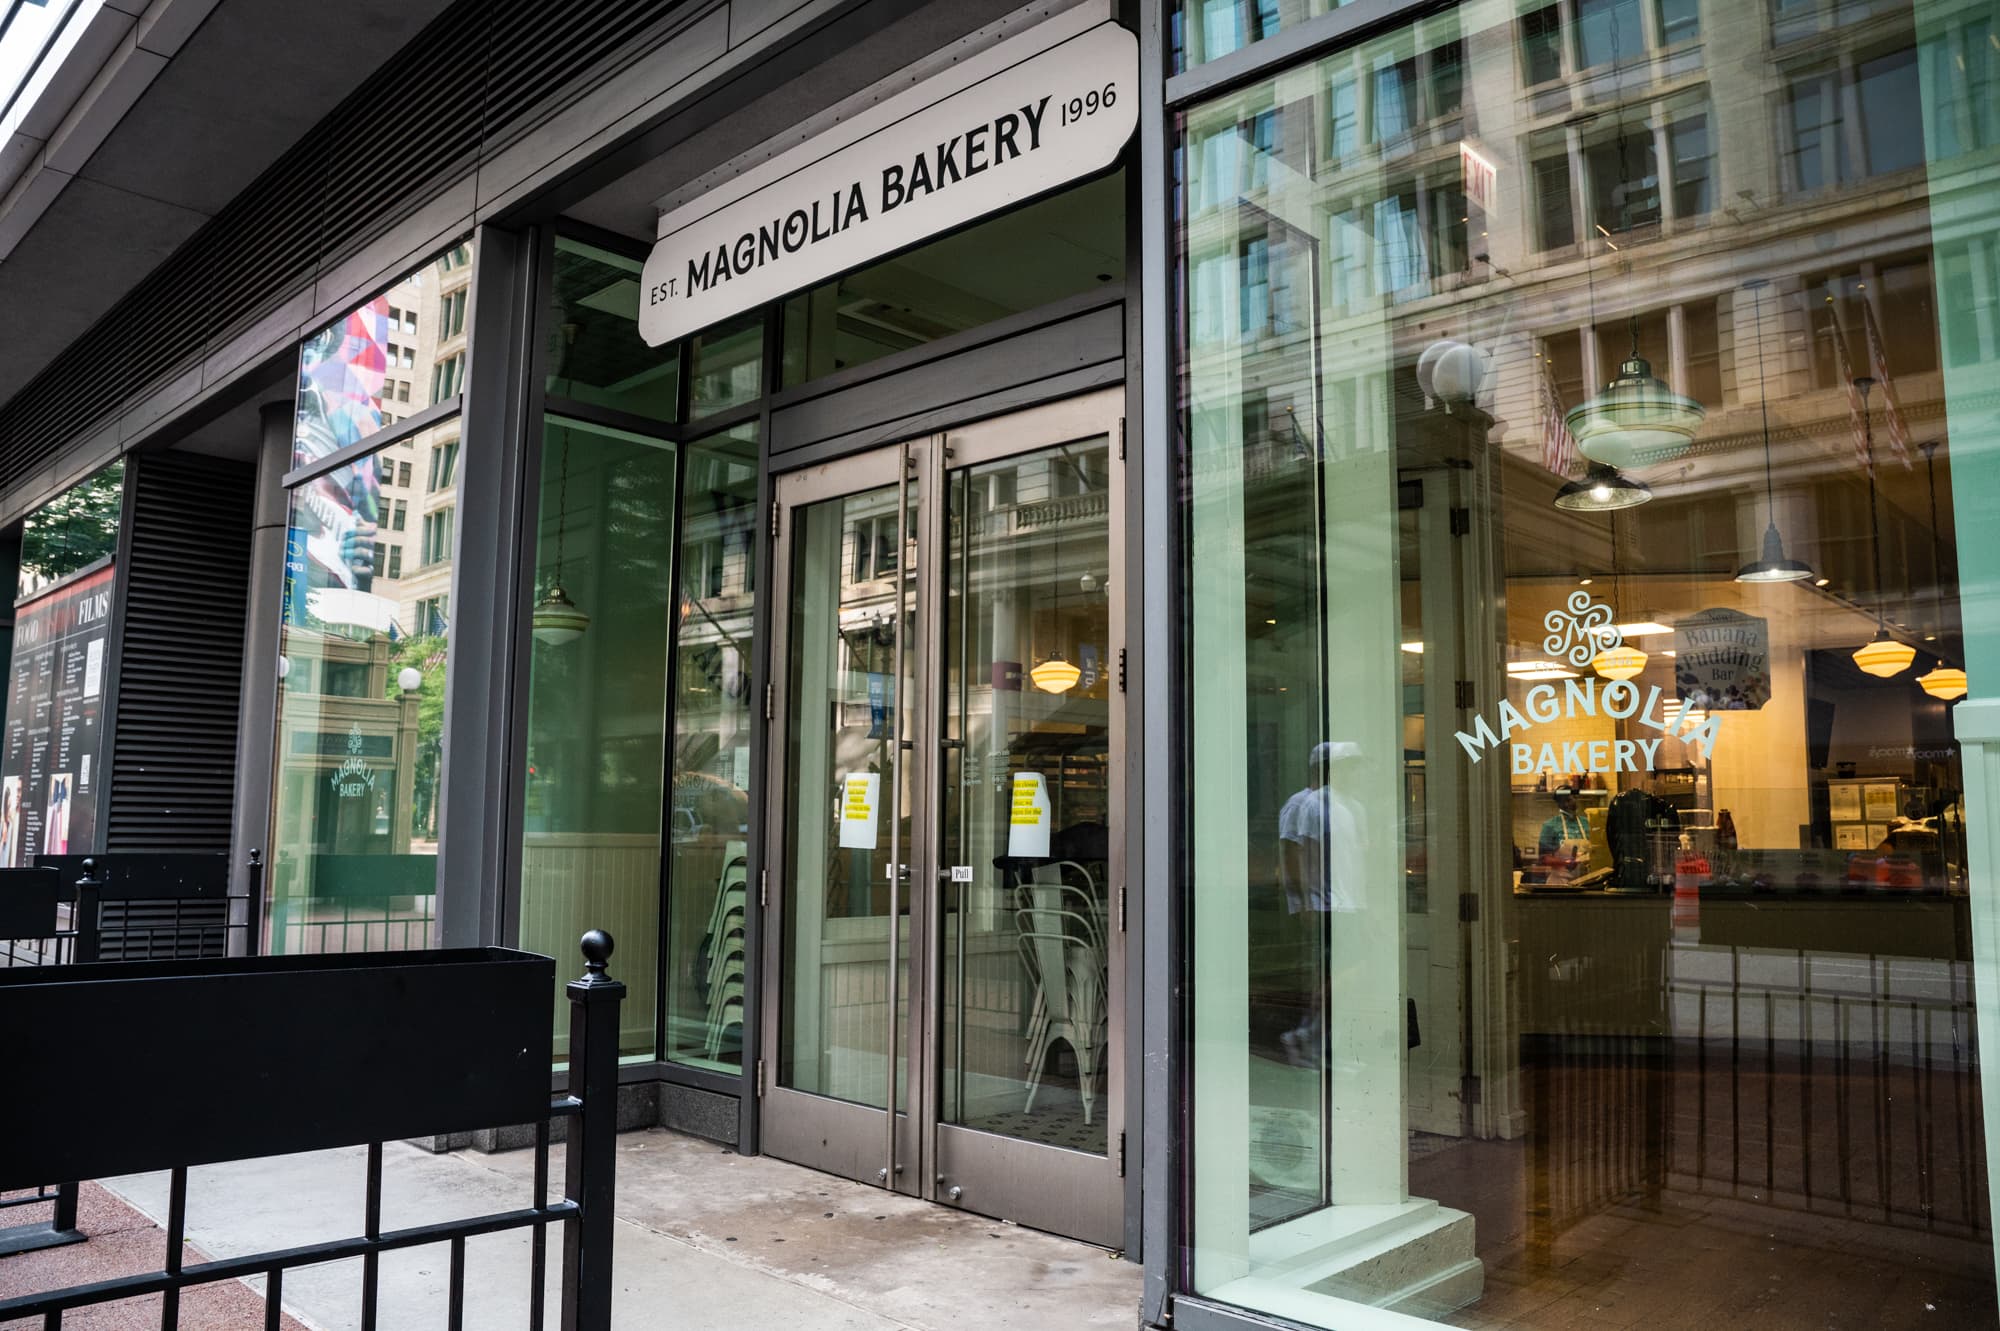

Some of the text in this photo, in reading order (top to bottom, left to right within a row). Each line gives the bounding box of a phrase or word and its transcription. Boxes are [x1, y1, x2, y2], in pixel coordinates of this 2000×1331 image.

[650, 82, 1118, 306] EST. MAGNOLIA BAKERY 1996
[1463, 151, 1494, 209] EXIT
[16, 619, 39, 649] FOOD
[78, 591, 109, 625] FILMS
[1685, 626, 1758, 648] Banana
[1682, 646, 1767, 673] Pudding
[1712, 668, 1735, 681] Bar
[1453, 676, 1724, 765] MAGNOLIA
[331, 756, 375, 792] MAGNOLIA
[1511, 737, 1663, 775] BAKERY
[339, 783, 365, 797] BAKERY
[955, 868, 969, 879] Pull
